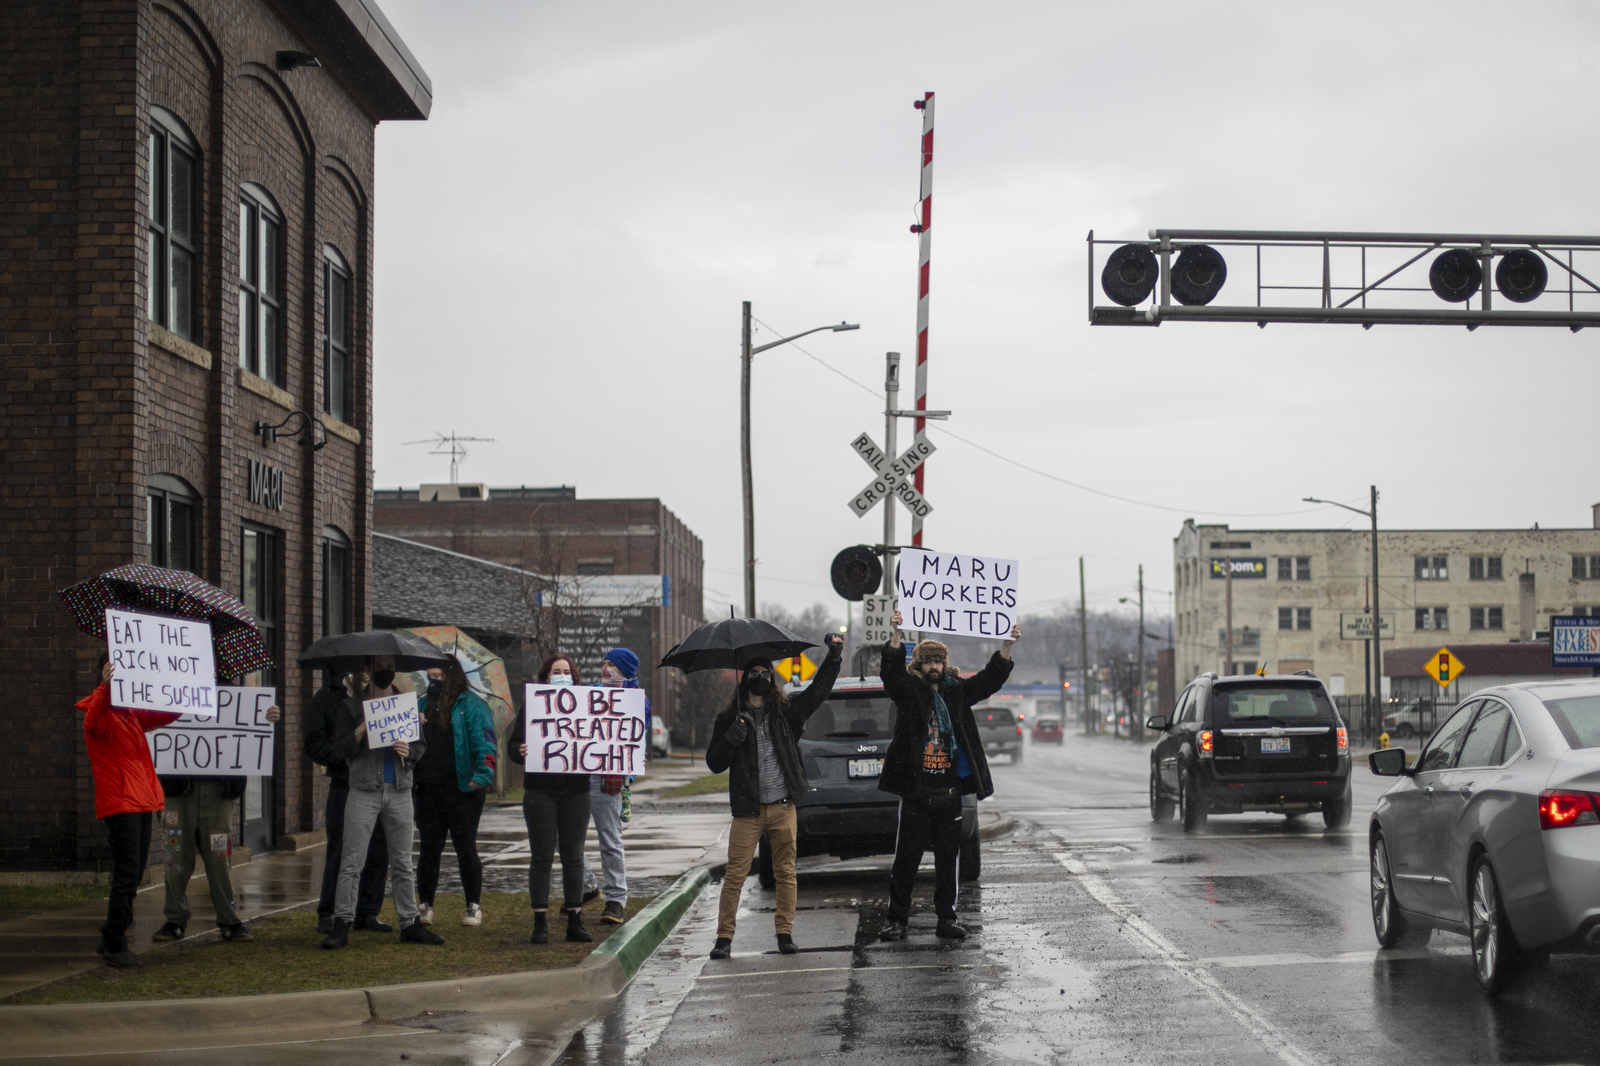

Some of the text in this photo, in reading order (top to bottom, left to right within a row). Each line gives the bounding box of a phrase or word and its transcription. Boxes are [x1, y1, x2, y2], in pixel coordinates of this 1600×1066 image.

[250, 459, 285, 511] MARU
[855, 436, 928, 517] RAIL ROAD
[855, 442, 929, 511] CROSSING
[922, 554, 1010, 582] MARU
[900, 579, 1016, 608] WORKERS
[112, 616, 191, 647] EAT THE
[865, 616, 883, 626] ON
[912, 606, 1011, 636] UNITED
[1556, 628, 1586, 640] FIVE
[1555, 639, 1586, 652] STAR
[112, 649, 200, 675] RICH, NOT
[113, 678, 213, 708] THE SUSHI
[369, 696, 399, 714] PUT
[534, 688, 626, 717] TO BE
[367, 707, 418, 732] HUMANS
[379, 720, 419, 744] FIRST
[530, 716, 645, 743] TREATED
[153, 732, 272, 770] PROFIT
[541, 740, 641, 774] RIGHT
[857, 744, 878, 753] Jeep
[850, 763, 864, 773] DWJ
